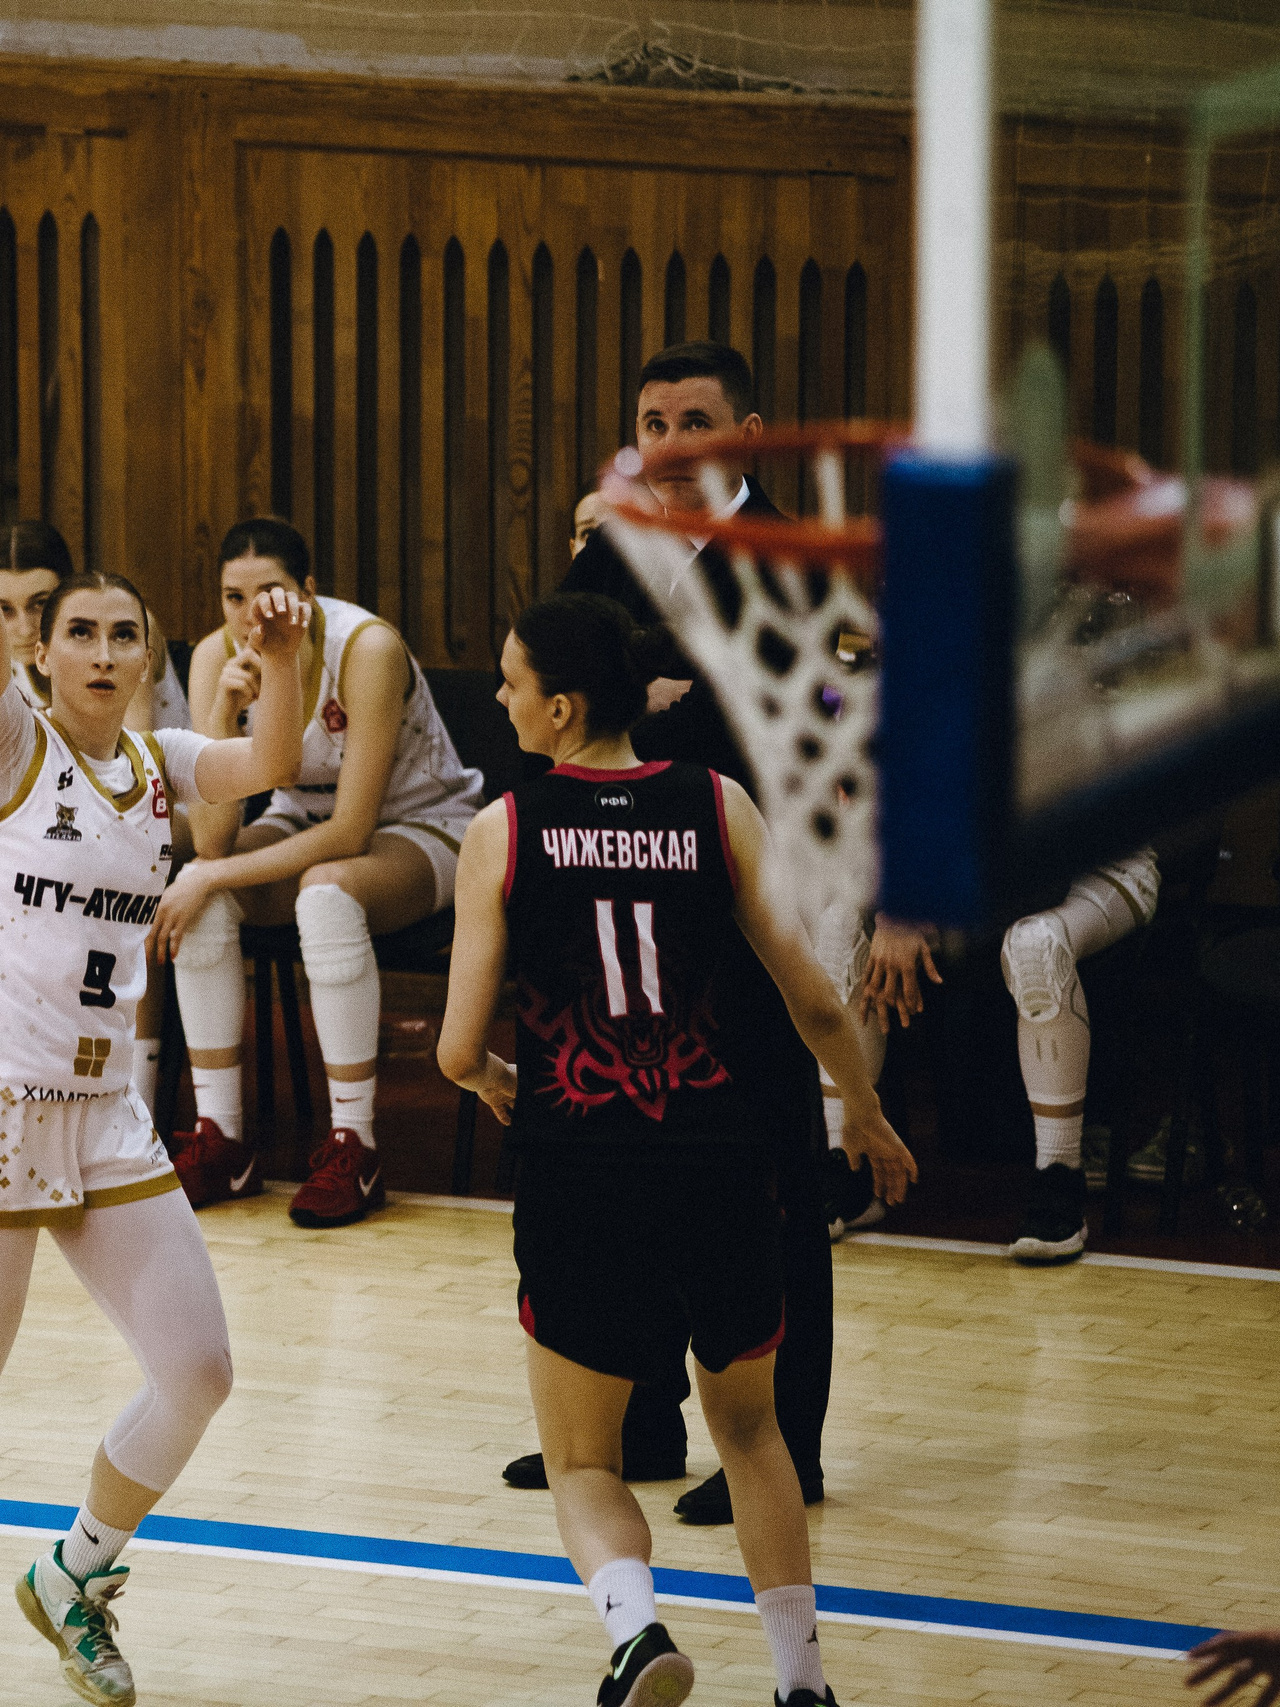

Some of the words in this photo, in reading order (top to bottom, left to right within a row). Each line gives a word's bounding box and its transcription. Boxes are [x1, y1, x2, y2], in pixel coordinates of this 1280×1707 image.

[542, 828, 697, 871] ЧИЖЕВСКАЯ
[79, 949, 116, 1009] 9
[594, 899, 664, 1017] 11
